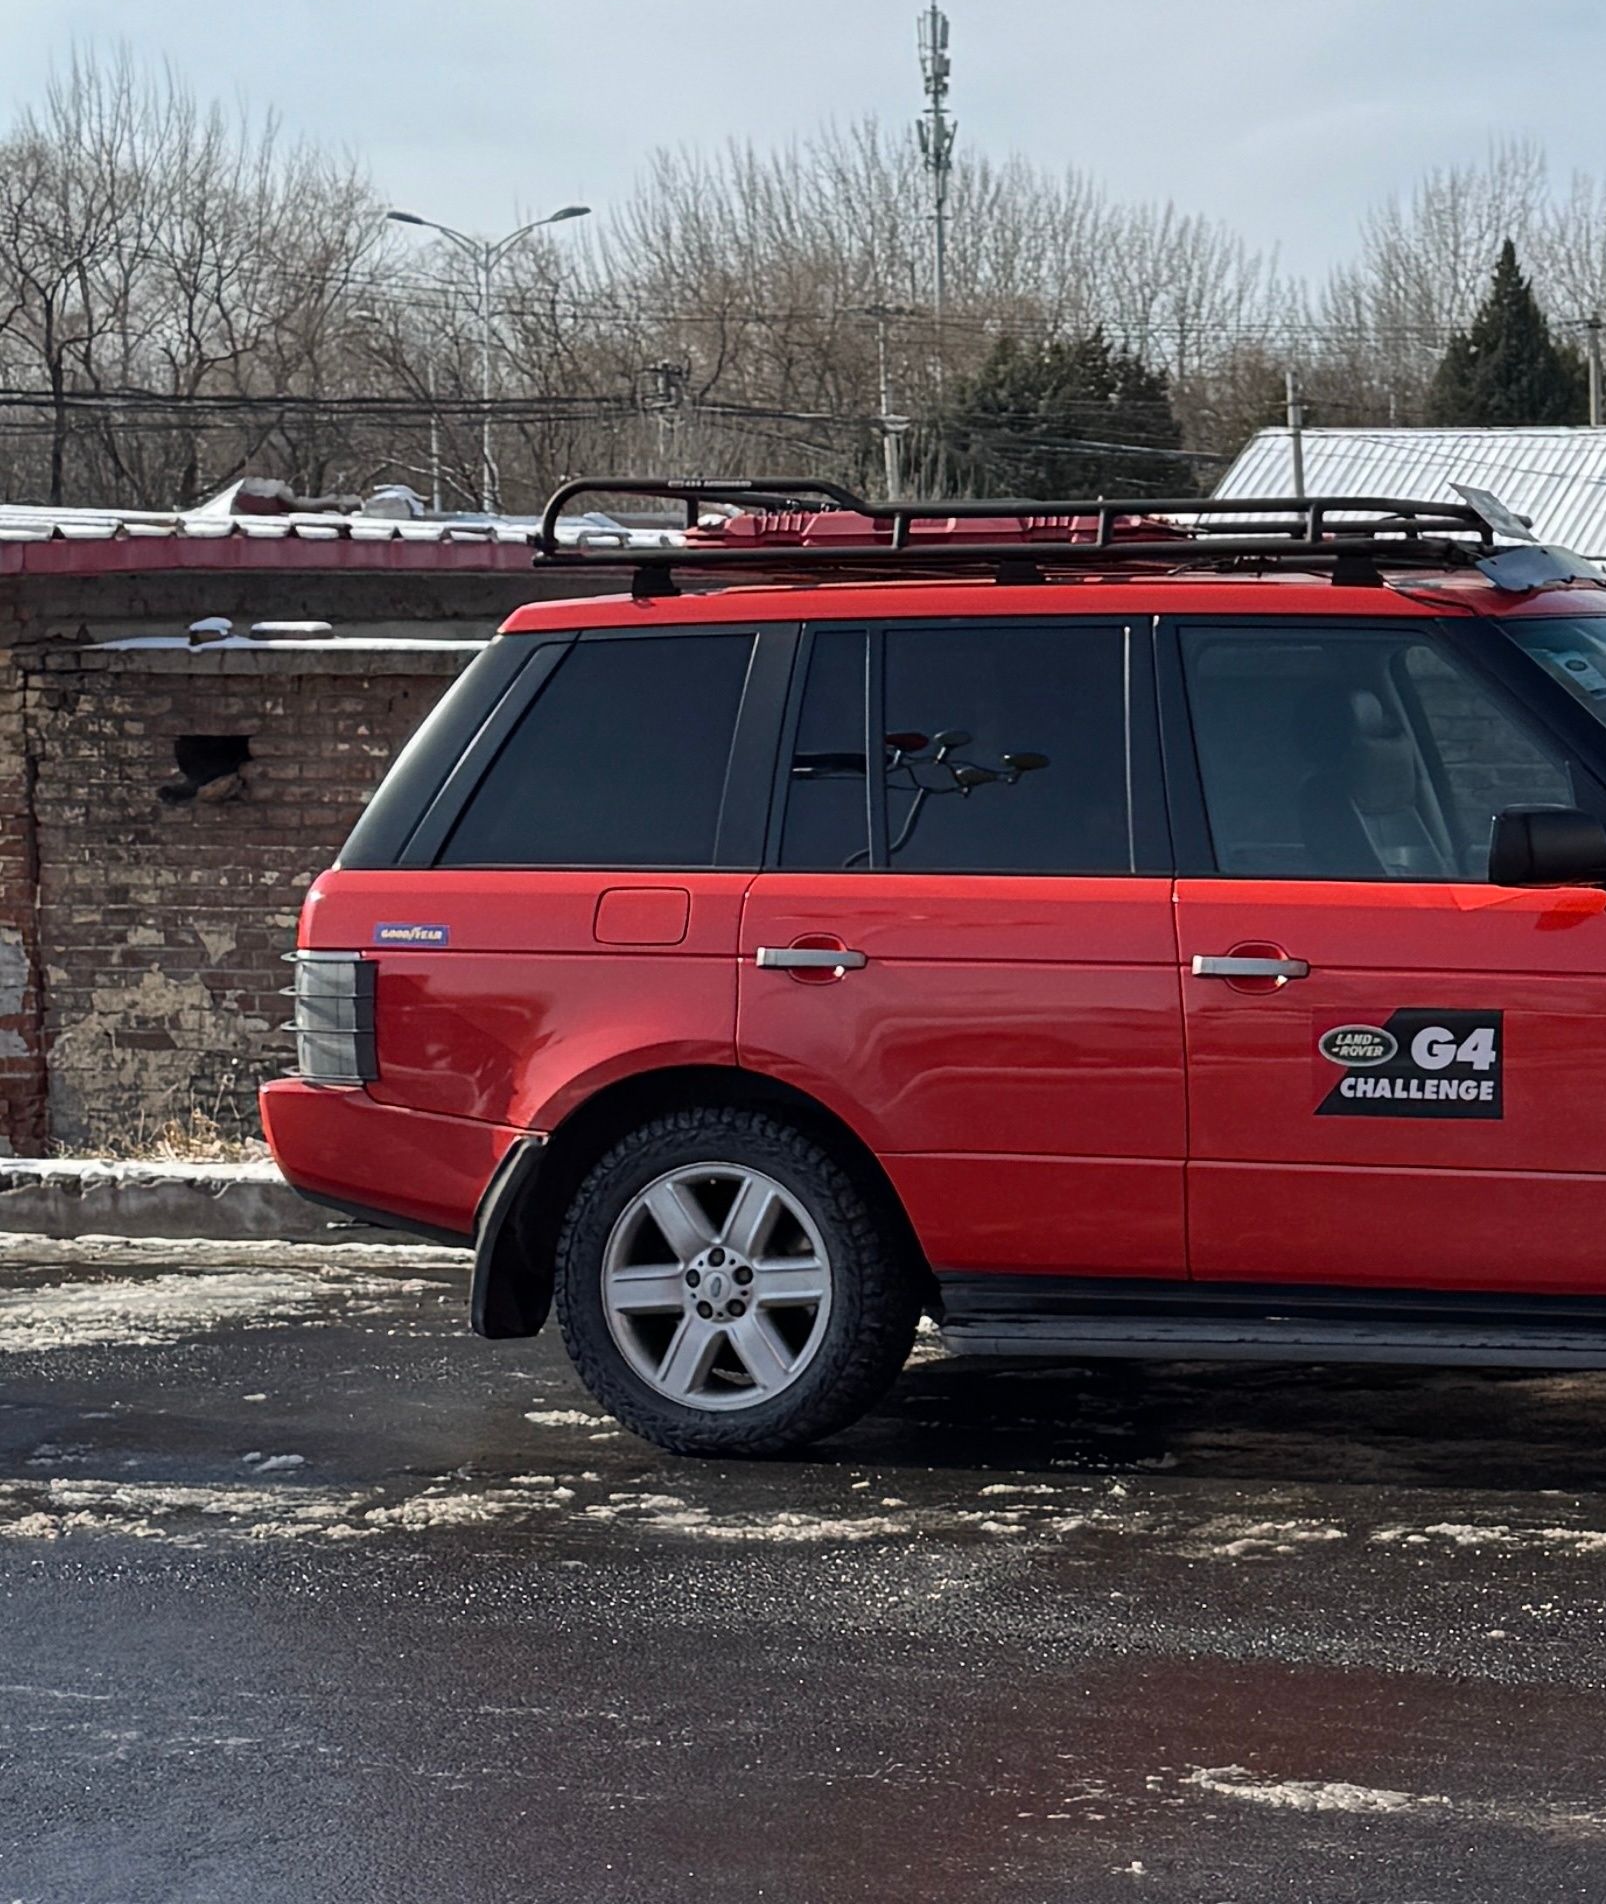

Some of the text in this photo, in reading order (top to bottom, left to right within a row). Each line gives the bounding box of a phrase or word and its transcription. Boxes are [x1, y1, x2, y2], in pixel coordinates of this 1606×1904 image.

[1335, 1033, 1373, 1045] LAND
[1410, 1025, 1497, 1071] G4
[1339, 1045, 1384, 1057] ROVER
[1339, 1077, 1495, 1101] CHALLENGE
